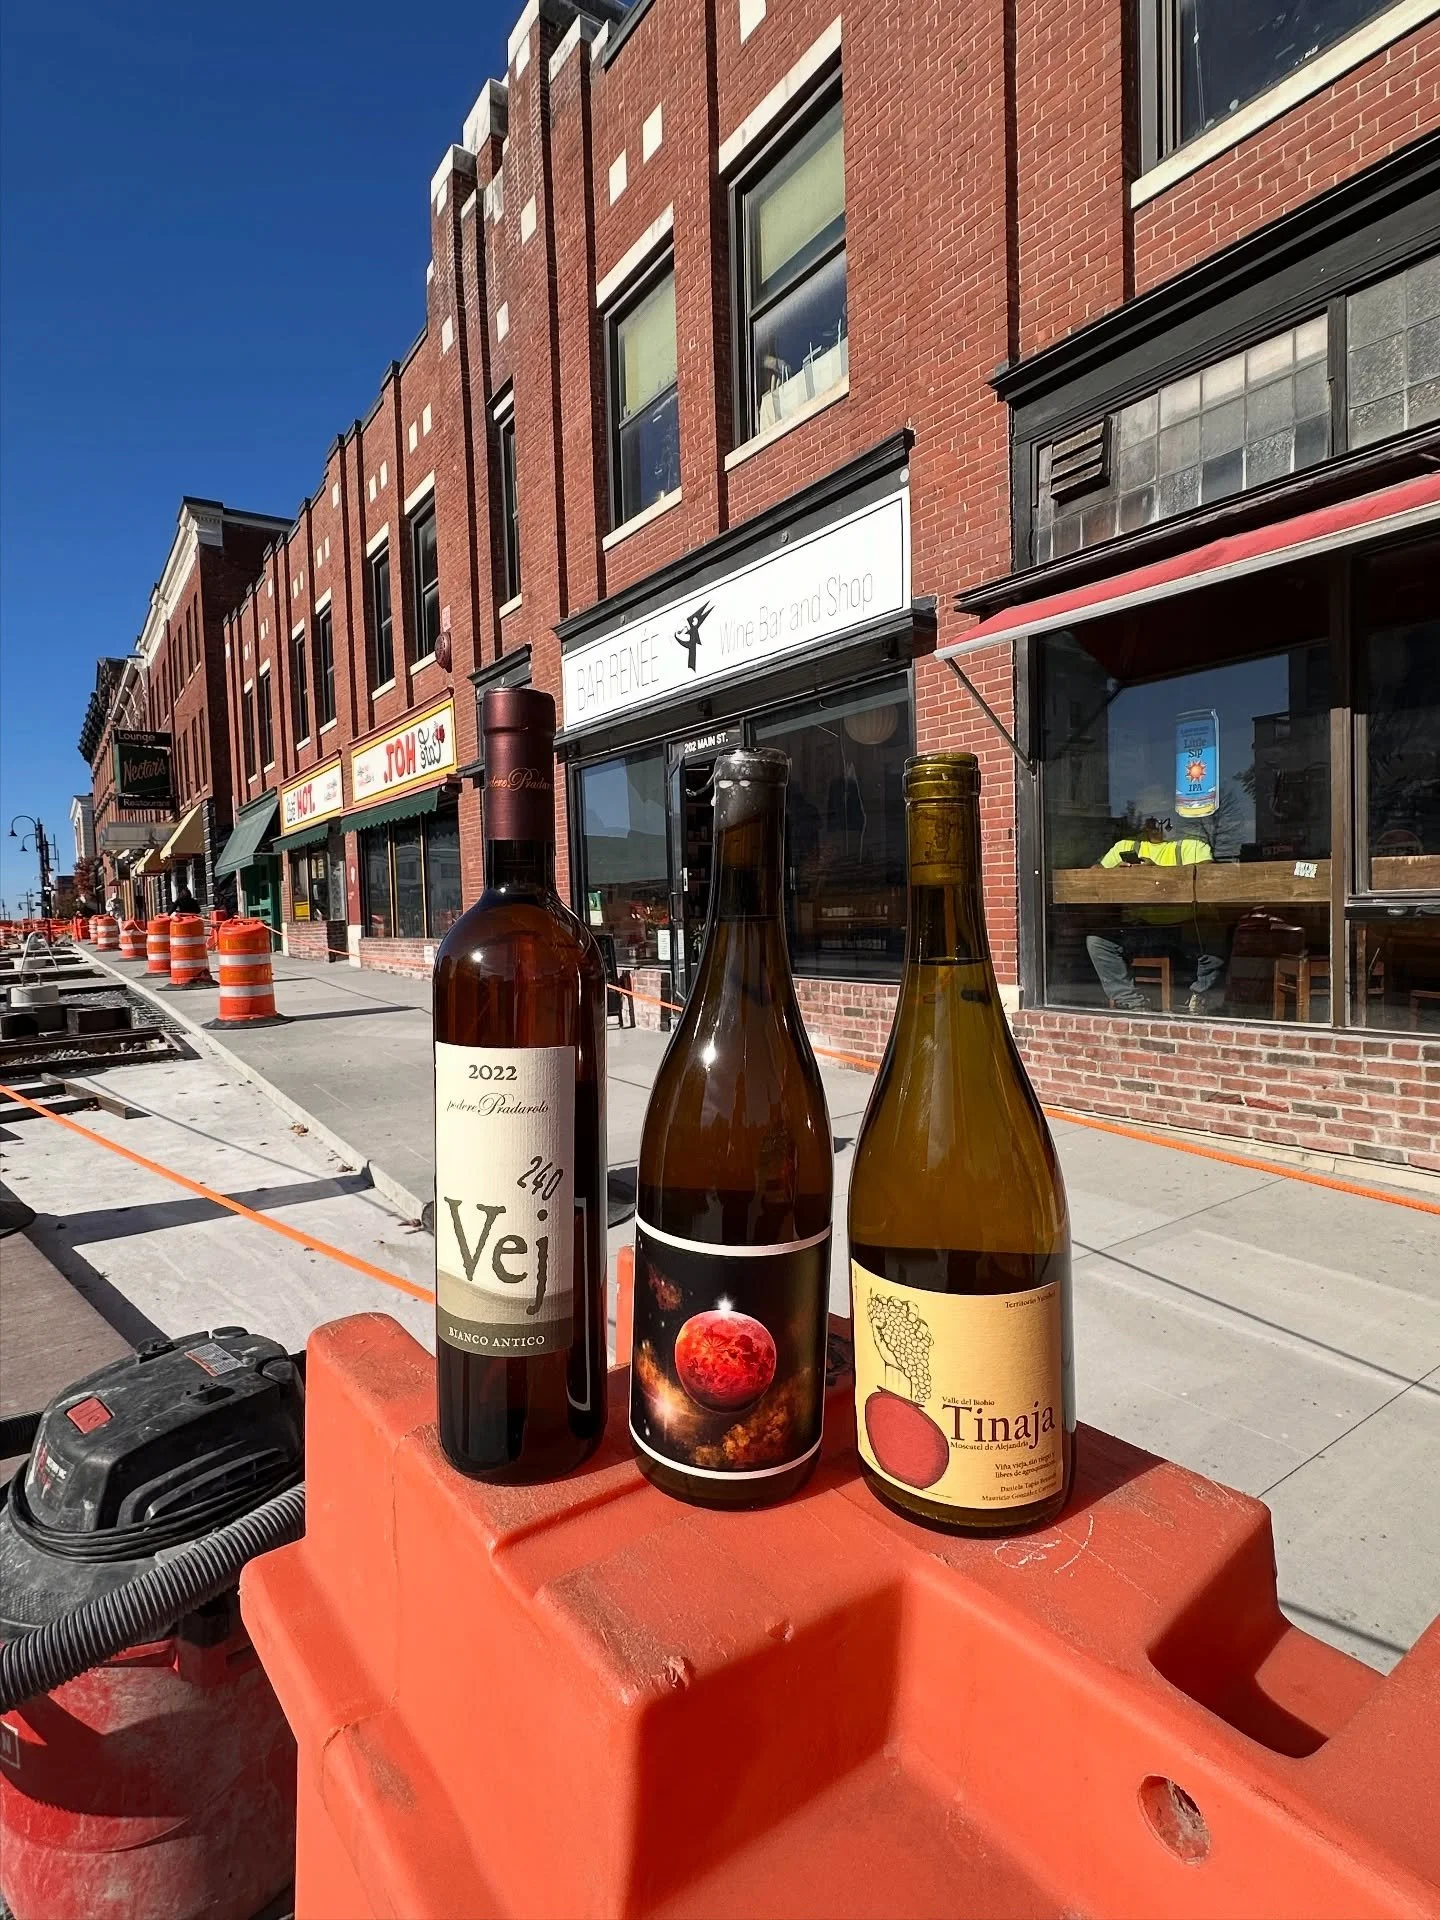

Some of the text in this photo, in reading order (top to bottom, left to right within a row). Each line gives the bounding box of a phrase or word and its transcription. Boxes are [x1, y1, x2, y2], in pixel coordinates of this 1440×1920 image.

[719, 572, 873, 657] Wine Bar and Shop
[576, 627, 660, 712] BAR RENÉE
[118, 731, 156, 744] Lounge
[683, 732, 729, 754] 202 MAIN ST.
[123, 756, 167, 789] Nectar's
[1188, 784, 1203, 792] IPA
[468, 1064, 518, 1081] 2022
[446, 1092, 550, 1117] podere Pradarolo
[516, 1155, 564, 1201] 240
[443, 1196, 549, 1315] Vej
[448, 1326, 546, 1348] BIANCO ANTICO
[942, 1396, 960, 1405] Valle
[941, 1401, 1056, 1450] Tinaja
[950, 1441, 983, 1451] Moscatel
[985, 1442, 994, 1450] de
